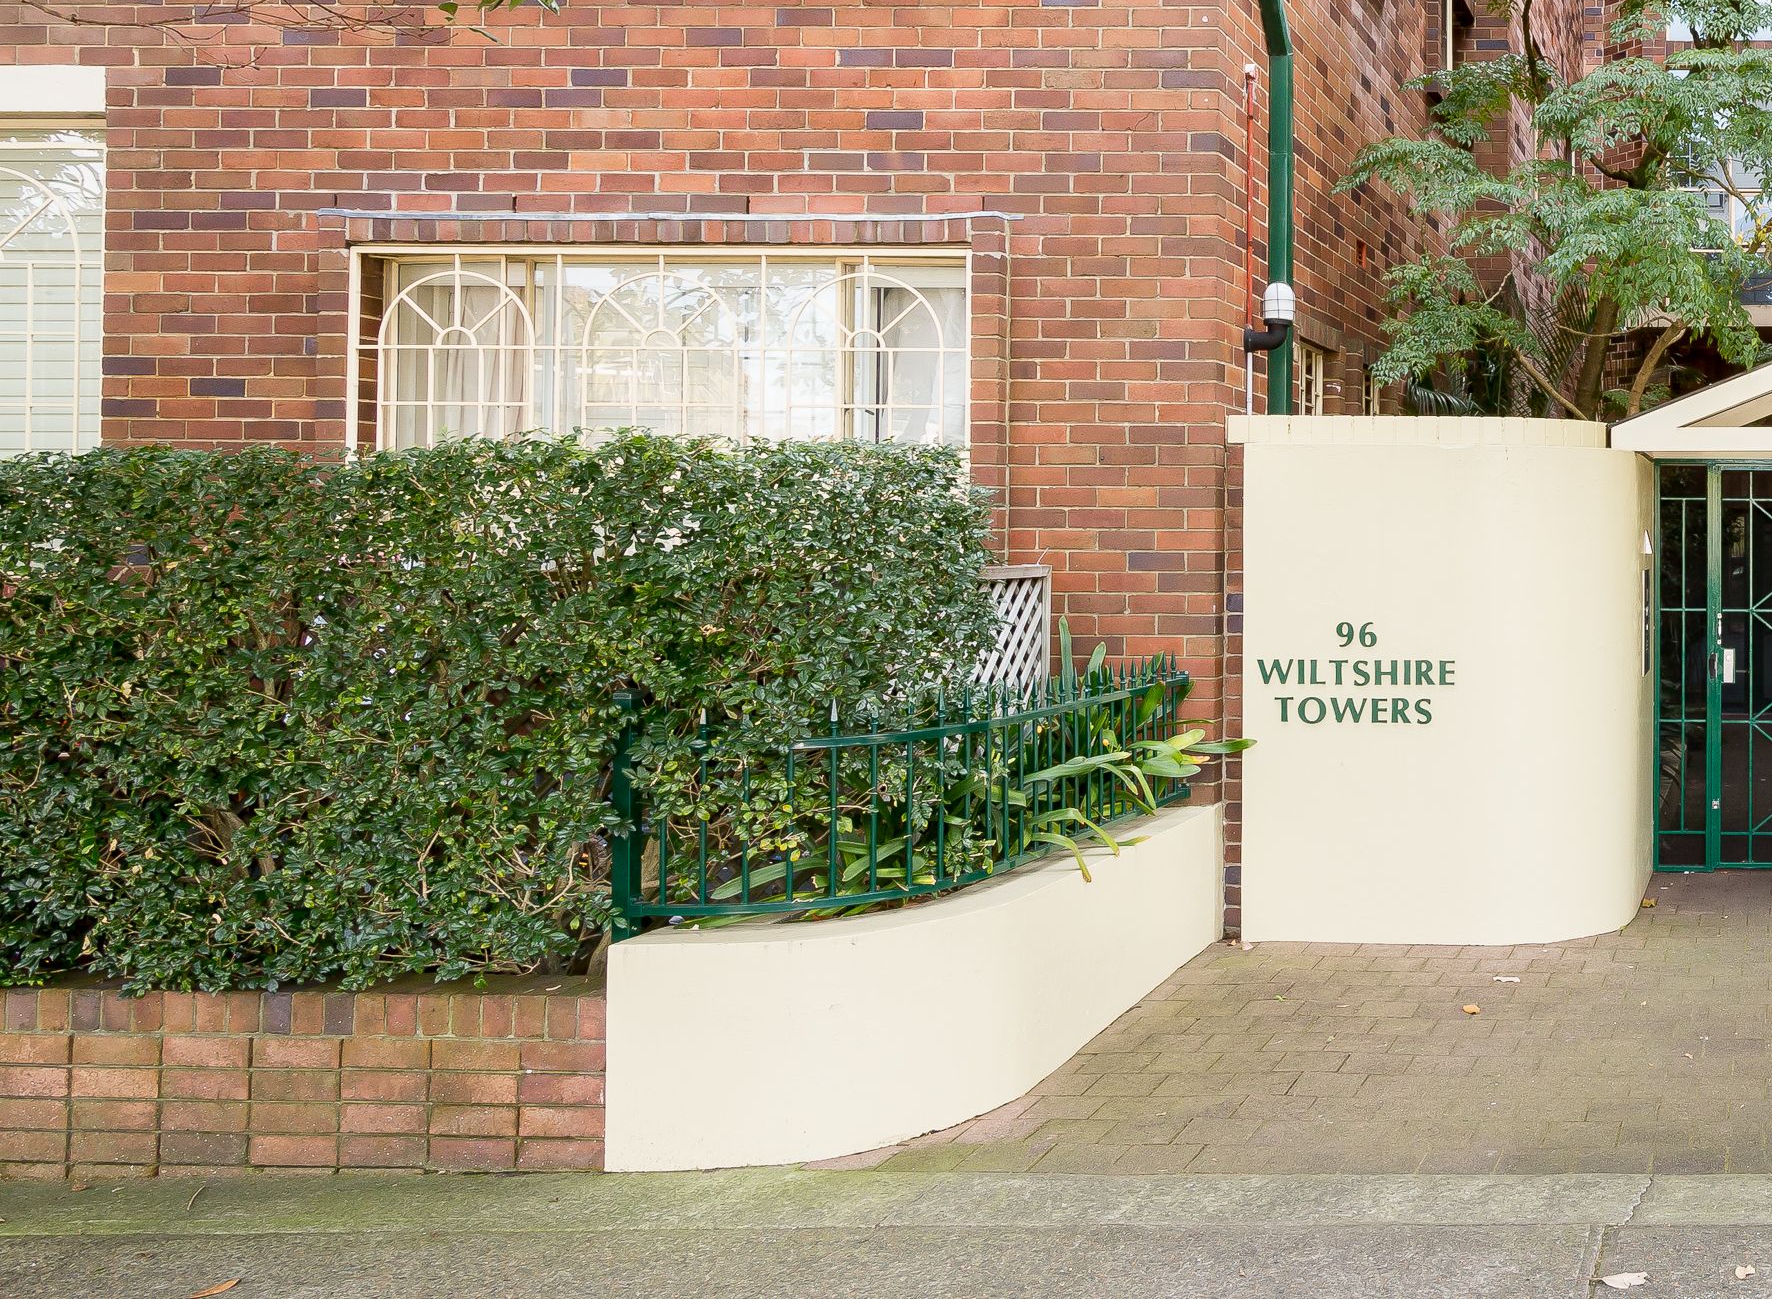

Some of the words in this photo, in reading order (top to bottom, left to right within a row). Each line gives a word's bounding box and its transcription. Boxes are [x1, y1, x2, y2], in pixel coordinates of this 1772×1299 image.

[1335, 621, 1378, 648] 96
[1256, 658, 1456, 687] WILTSHIRE
[1274, 696, 1433, 725] TOWERS
